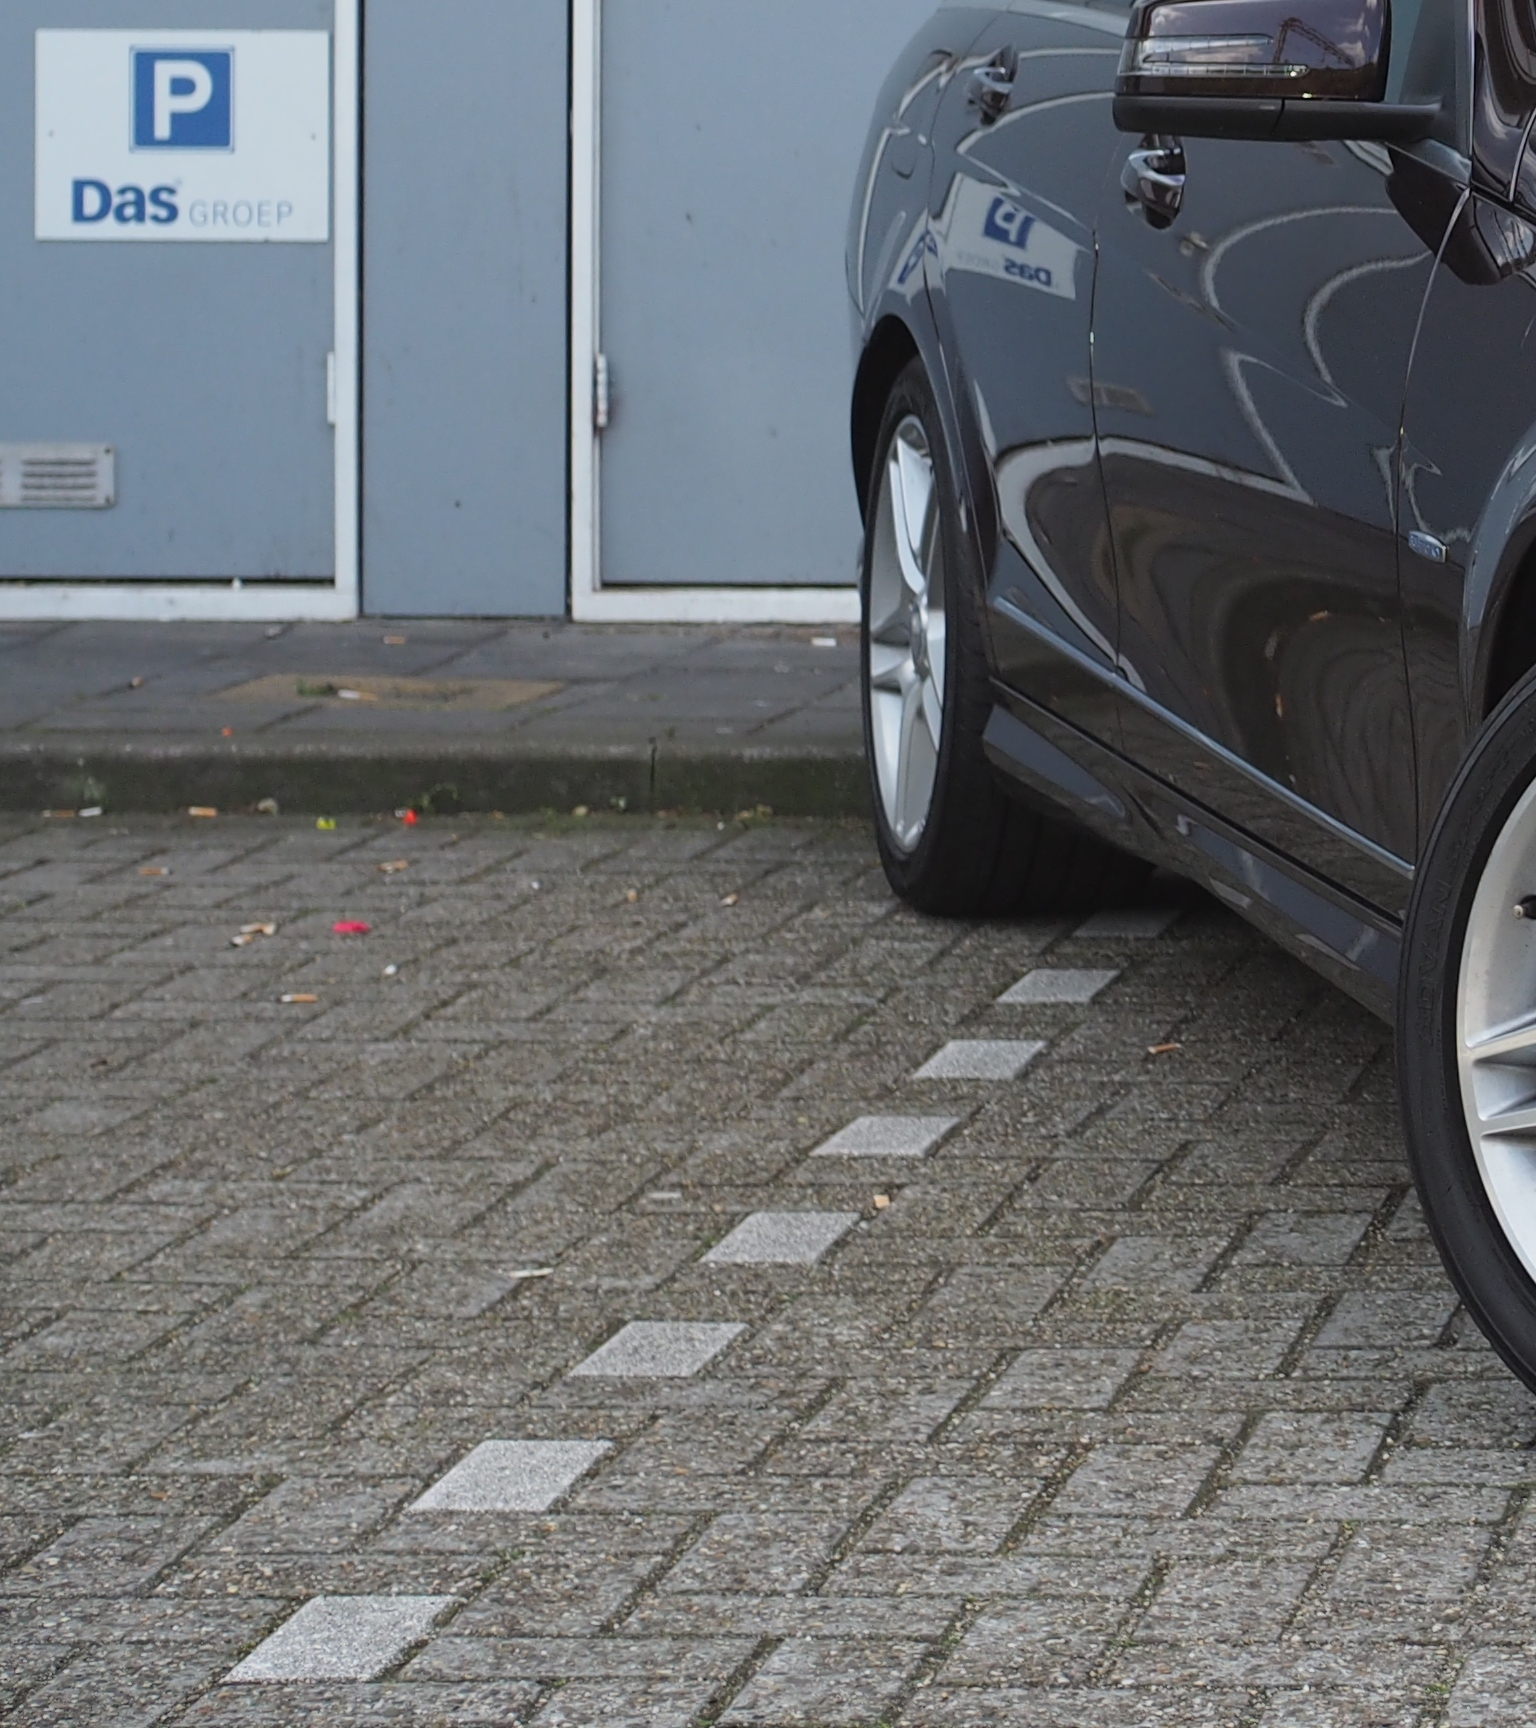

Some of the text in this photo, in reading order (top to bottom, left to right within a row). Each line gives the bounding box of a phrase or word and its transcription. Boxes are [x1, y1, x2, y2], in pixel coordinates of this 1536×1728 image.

[153, 60, 213, 140] P
[72, 178, 294, 227] Das GROEP
